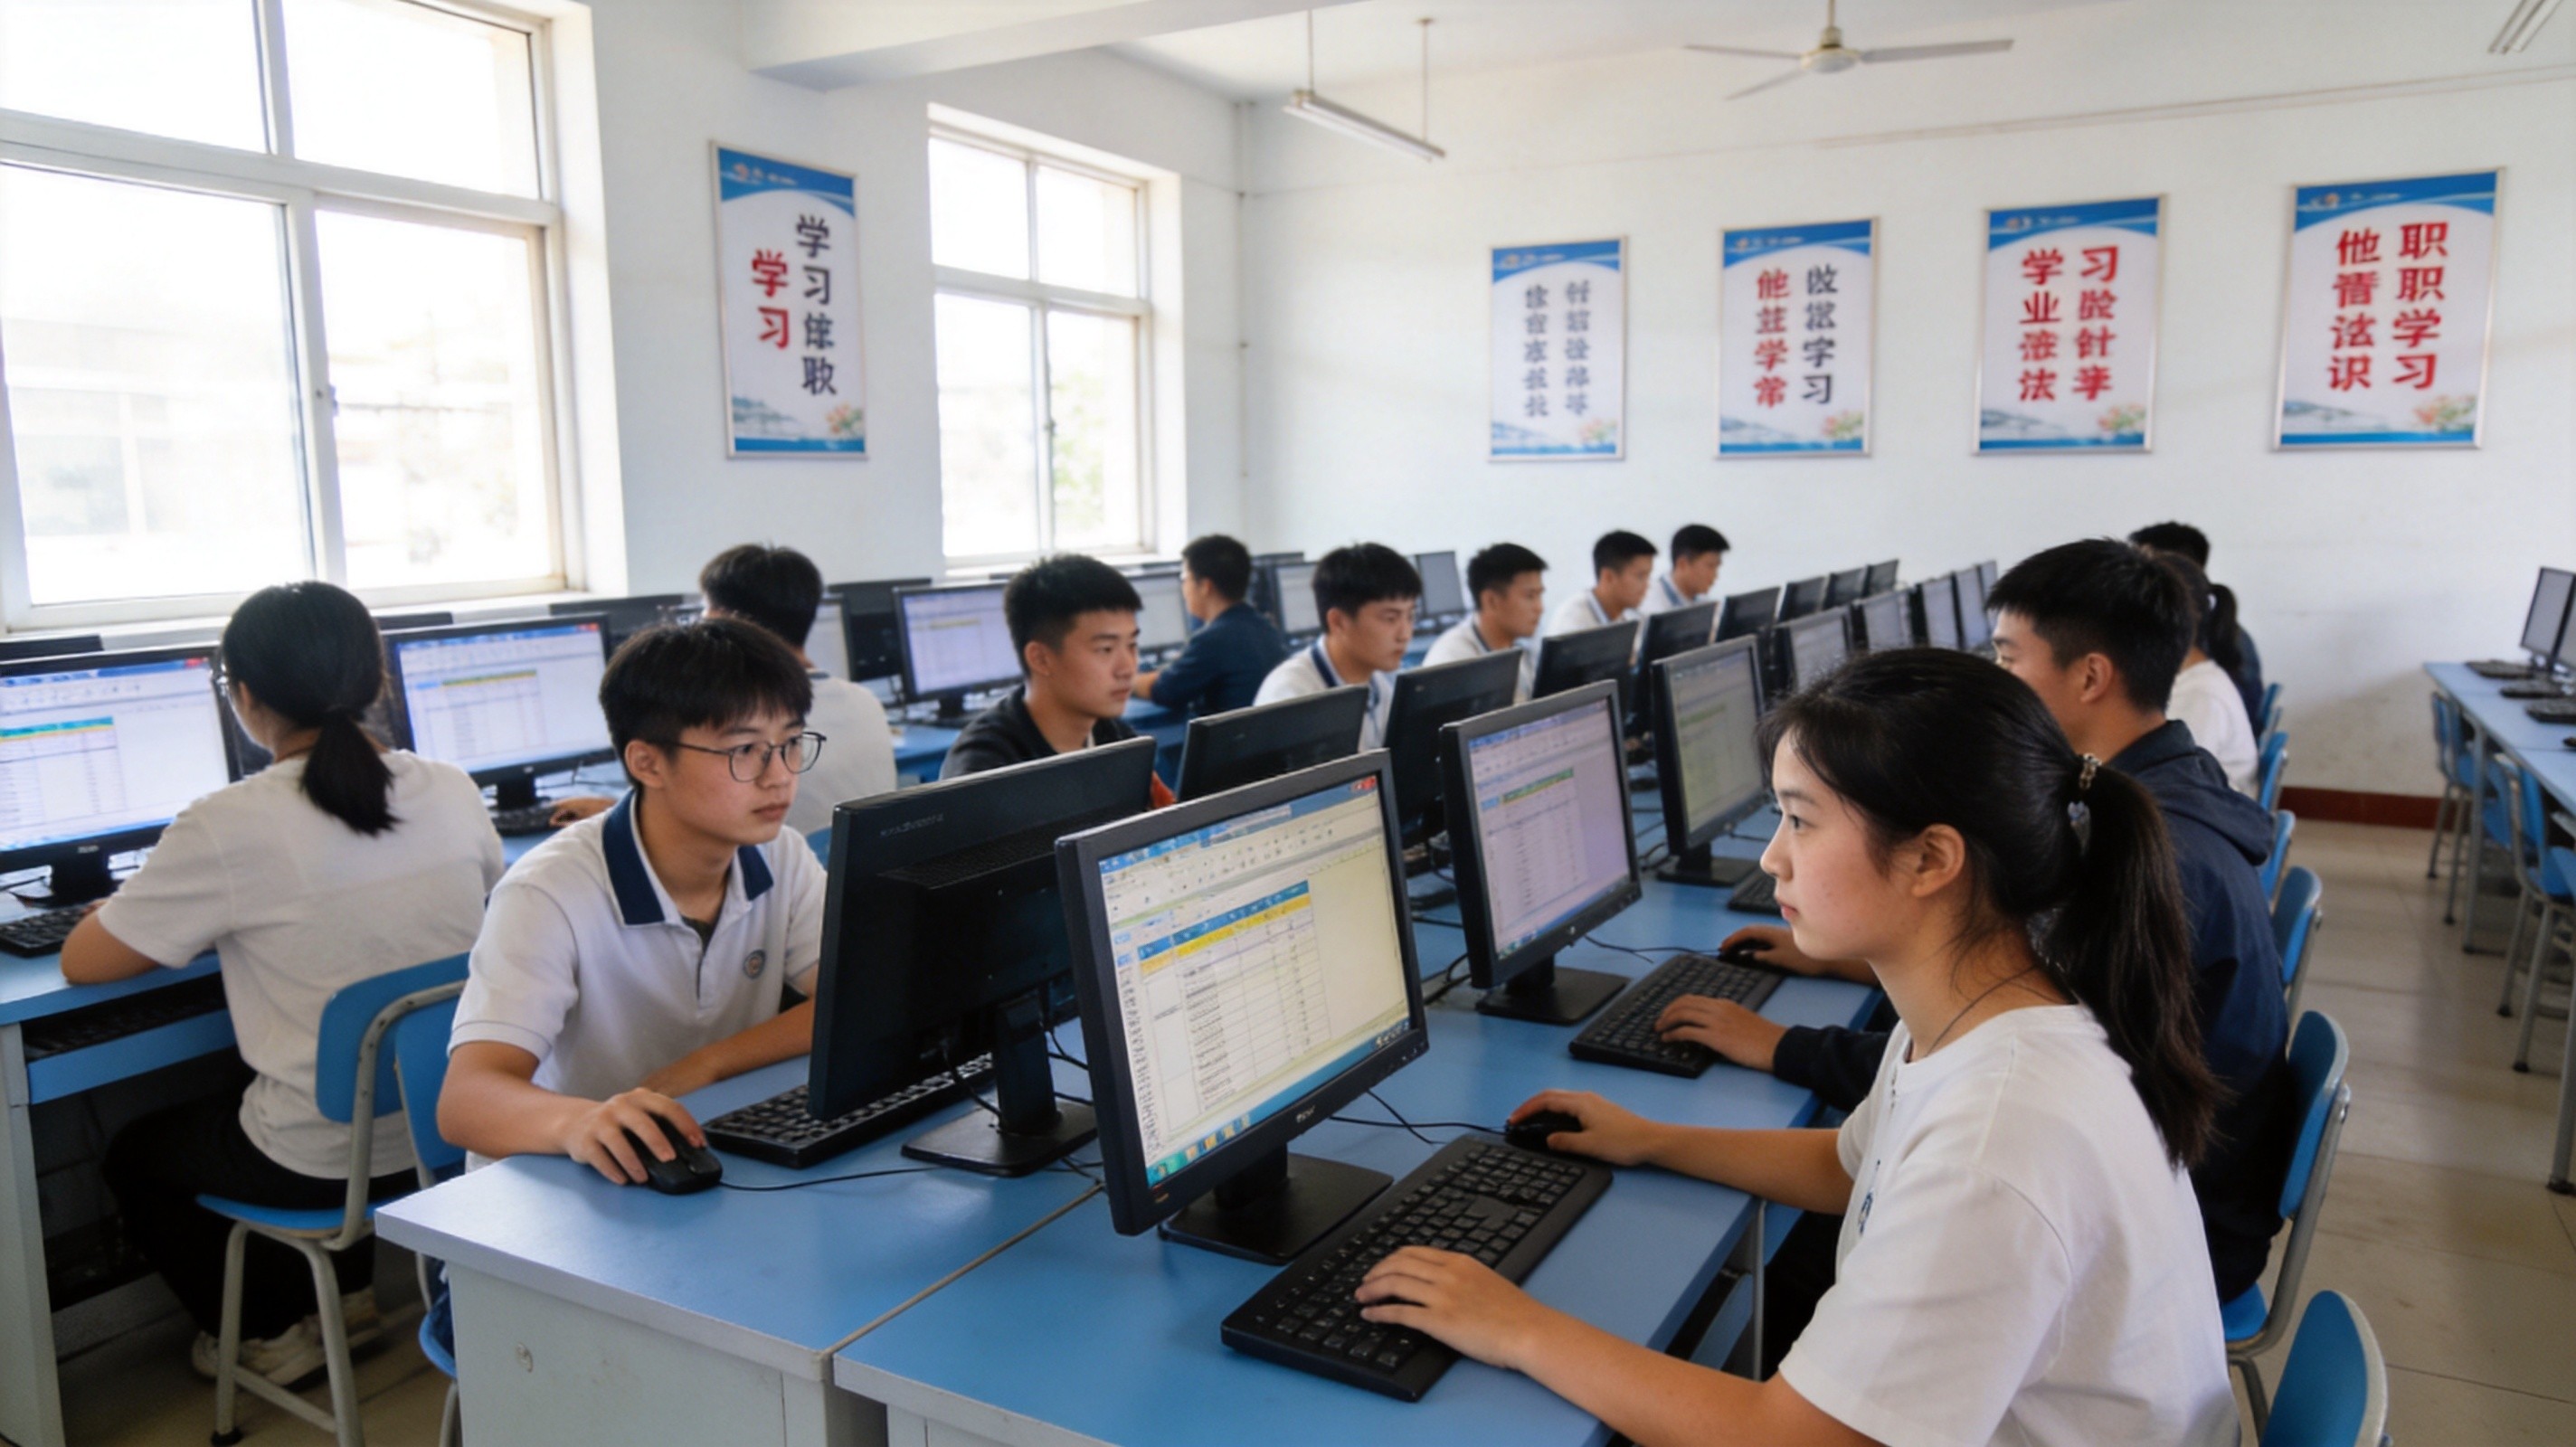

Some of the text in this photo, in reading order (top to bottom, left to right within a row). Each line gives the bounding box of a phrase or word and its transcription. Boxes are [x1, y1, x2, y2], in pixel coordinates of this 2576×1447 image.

[752, 249, 790, 349] 学习
[2392, 222, 2448, 390] 职职学习
